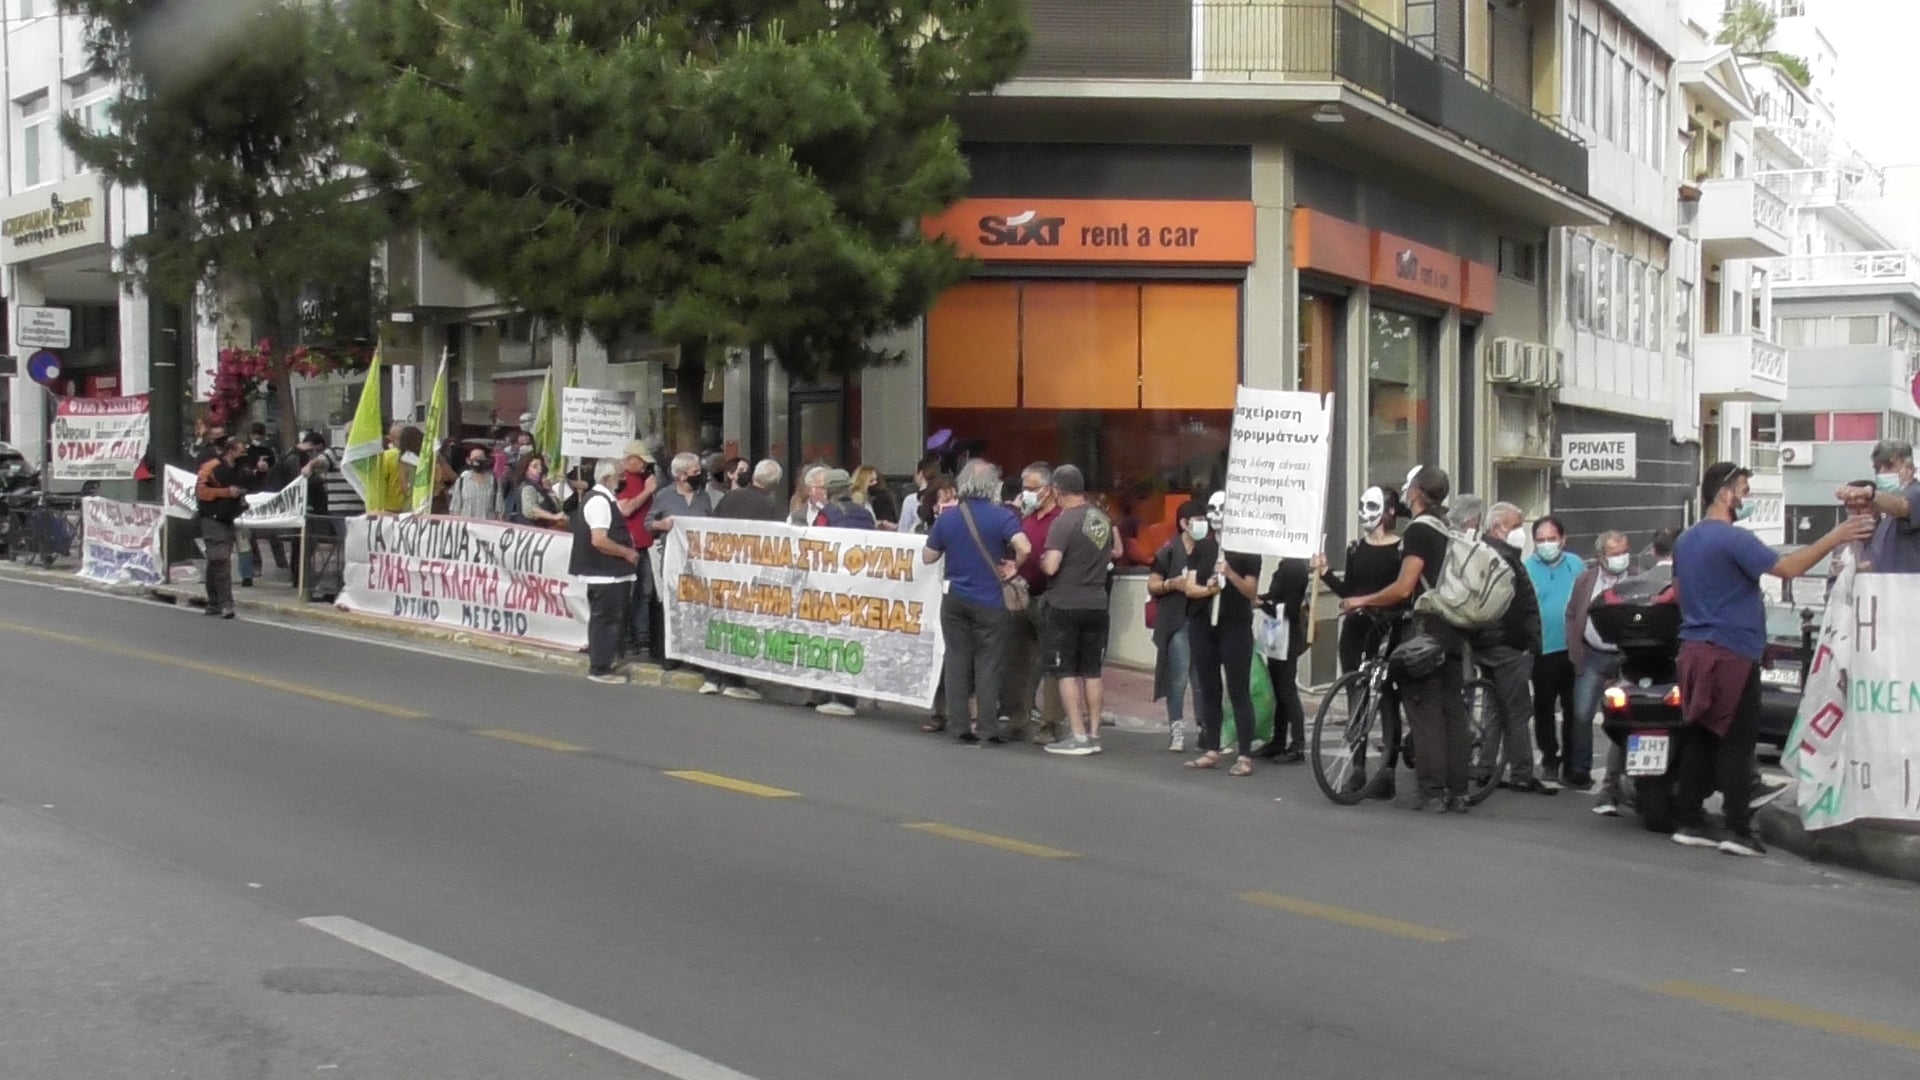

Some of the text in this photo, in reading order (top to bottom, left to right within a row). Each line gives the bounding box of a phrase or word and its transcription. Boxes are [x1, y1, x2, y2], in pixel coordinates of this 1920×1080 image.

[1080, 223, 1129, 247] rent
[1137, 227, 1150, 247] a
[1159, 227, 1199, 248] car
[1236, 405, 1302, 423] αχείριση
[1568, 441, 1626, 454] PRIVATE
[1569, 458, 1625, 471] CABINS
[366, 515, 386, 552] ΤΑ
[391, 515, 469, 562] ΣΚΟΥΠΙΔΙΑ
[499, 527, 555, 575] ΦΥΛΗ
[796, 537, 841, 573] ΣΤΗ
[843, 544, 915, 582] ΦΥΛΗ
[367, 552, 412, 594] ΕΙΝΑΙ
[419, 559, 499, 607] ΕΓΚΛΗΜΑ
[394, 594, 528, 636] ΔΥΤΙΚΟ ΜΕΤΩΠΟ
[796, 588, 924, 635] ΔΙΑΡΚΕΙΑΣ
[763, 628, 865, 676] ΜΕΤΩΠΟ
